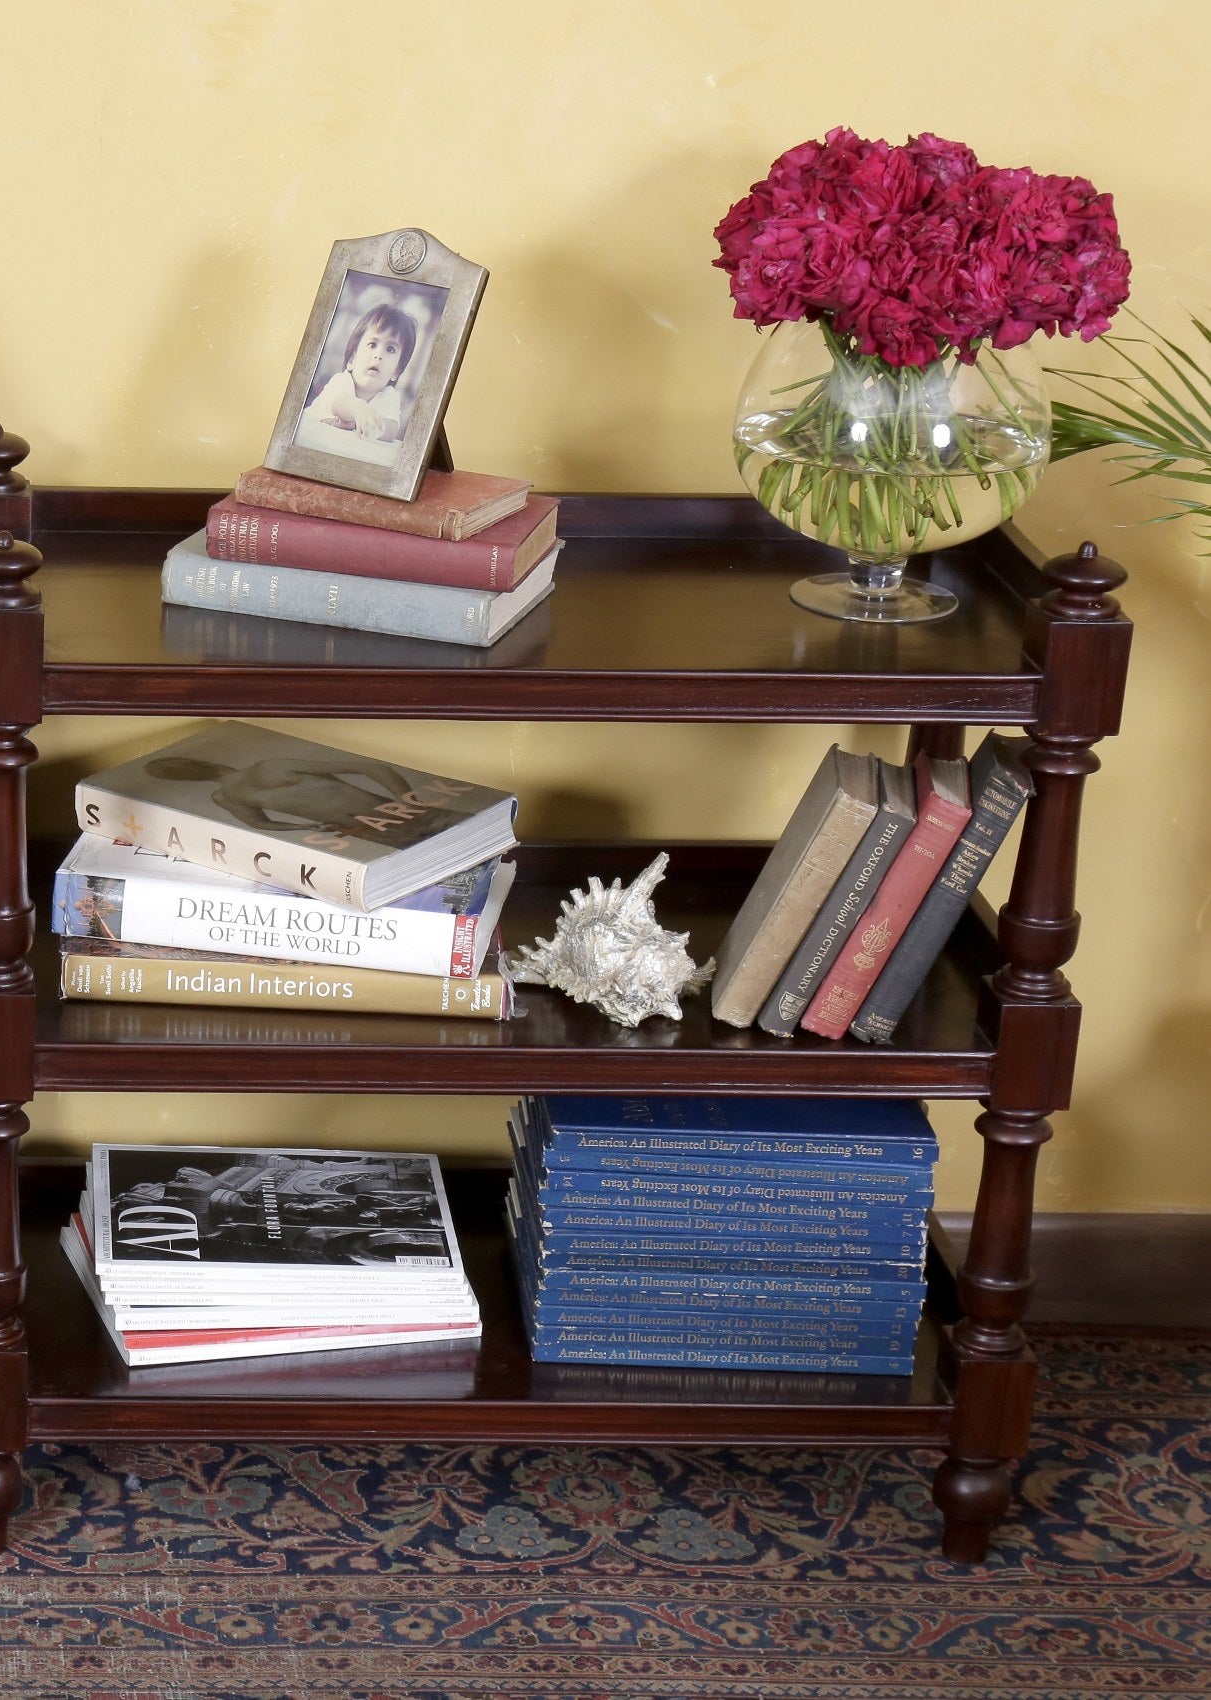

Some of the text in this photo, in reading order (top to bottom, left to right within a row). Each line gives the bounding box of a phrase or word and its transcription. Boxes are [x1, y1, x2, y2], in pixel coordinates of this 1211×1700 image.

[219, 513, 229, 540] POLICY
[270, 523, 279, 544] POOL
[489, 545, 500, 587] MACMILLAN
[879, 823, 898, 846] THE
[855, 846, 884, 891] OXFORD
[176, 897, 398, 941] DREAM ROUTES
[835, 892, 860, 929] School
[209, 926, 361, 956] OF THE WORLD
[453, 926, 465, 954] INSIGHT
[461, 918, 475, 963] ILLUSTRATED
[798, 927, 839, 993] DICTIONARY
[166, 969, 354, 999] Indian Interiors
[442, 978, 450, 1011] TASCHEN
[578, 1136, 883, 1158] America: An Illustrated Diary of Its Most Exciting Years
[913, 1148, 923, 1159] 16
[601, 1179, 908, 1204] America: An Illustrated Diary of Its Most Exciting Years
[261, 1177, 282, 1240] FLORA FOUNTAIN
[116, 1205, 200, 1260] AD
